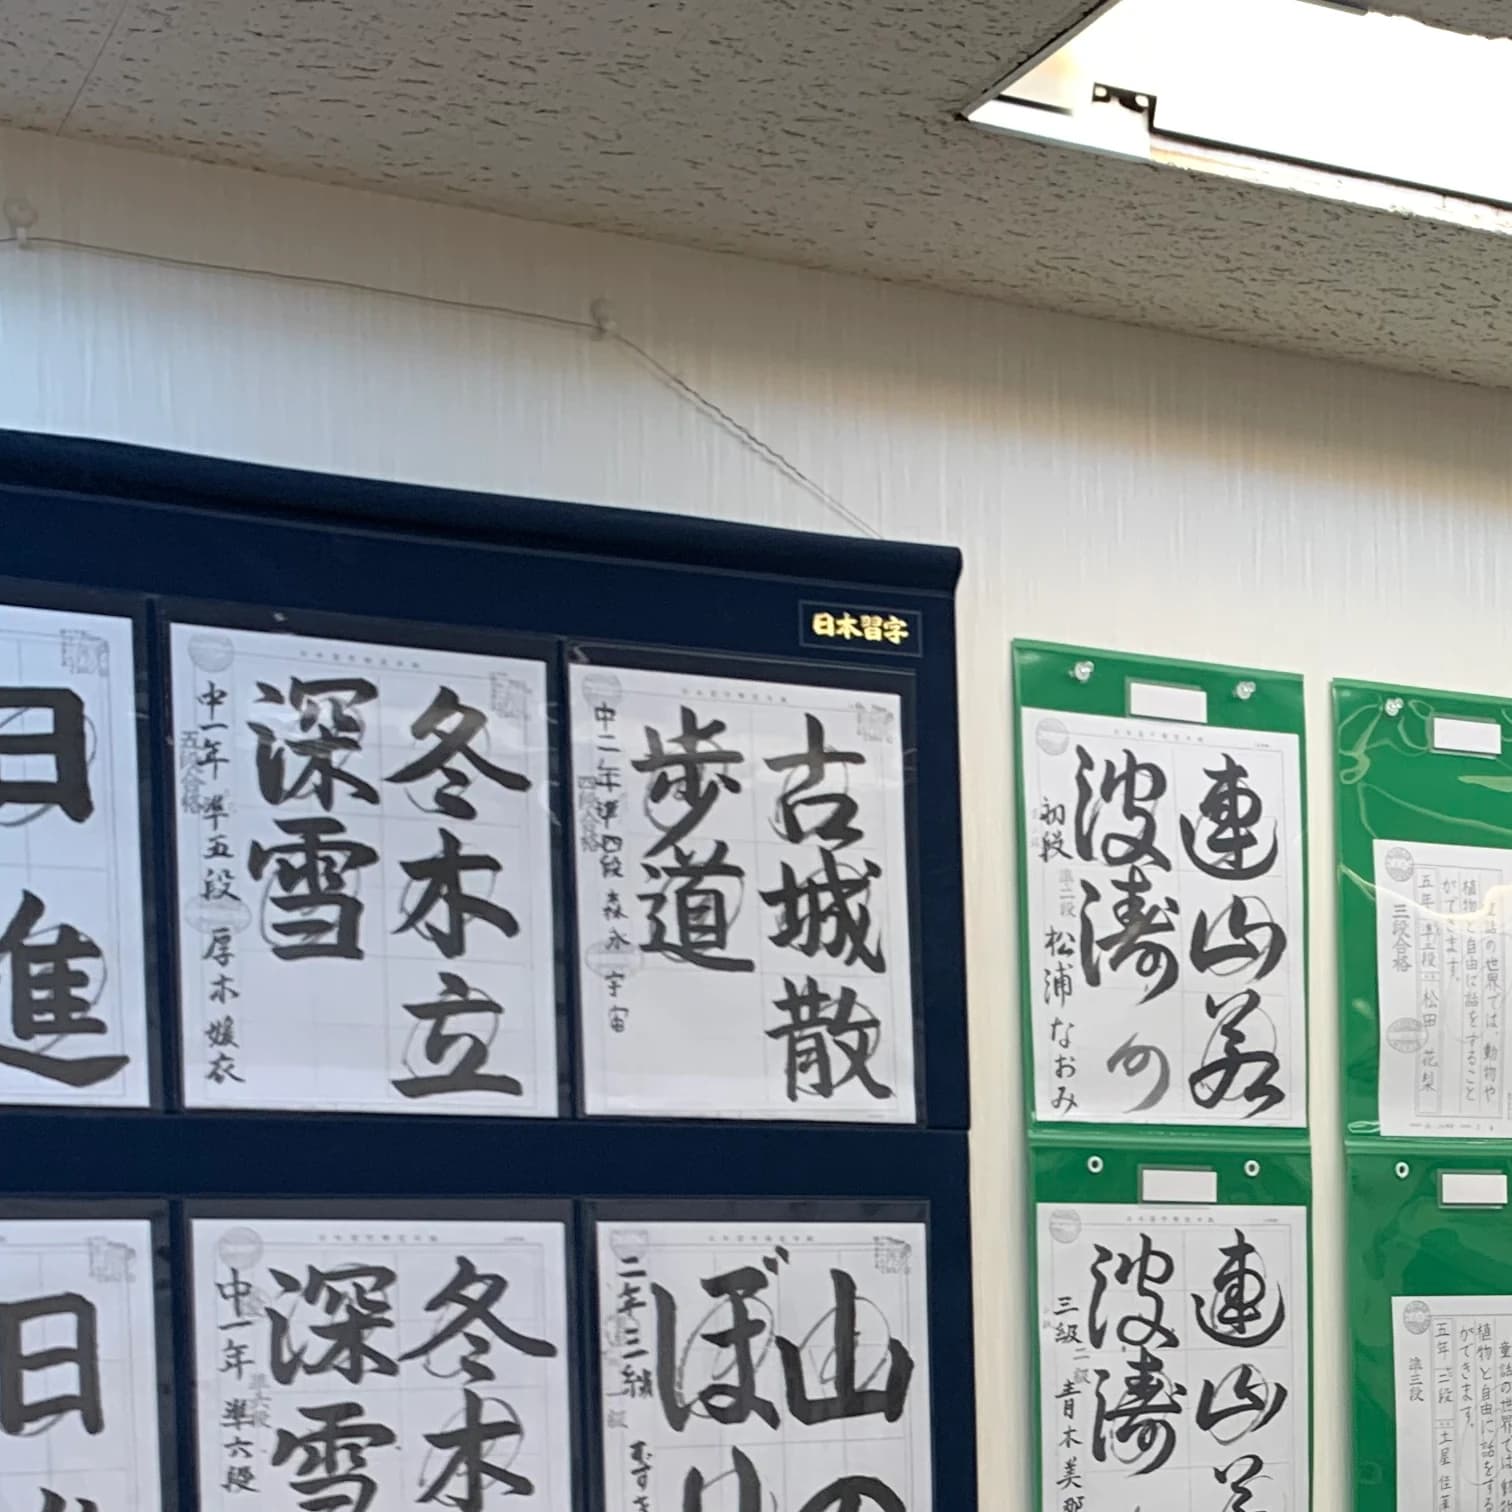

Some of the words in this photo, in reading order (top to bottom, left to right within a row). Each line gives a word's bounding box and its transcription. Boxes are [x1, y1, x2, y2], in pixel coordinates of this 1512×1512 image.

[811, 611, 909, 645] 日本習字
[196, 681, 230, 779] 中一年
[202, 794, 241, 901] 準五段
[247, 676, 380, 961] 深雪
[630, 704, 755, 974] 歩道
[1038, 797, 1074, 864] 初段
[384, 685, 532, 1098] 冬木立
[758, 712, 896, 1102] 古城散
[1392, 904, 1412, 973] 三段合格
[202, 927, 240, 1003] 厚木
[1042, 924, 1076, 1008] 松浦
[1048, 1016, 1079, 1117] なおみ
[216, 1267, 257, 1380] 中一年
[1053, 1296, 1083, 1346] 三級
[1434, 1322, 1451, 1358] 五年
